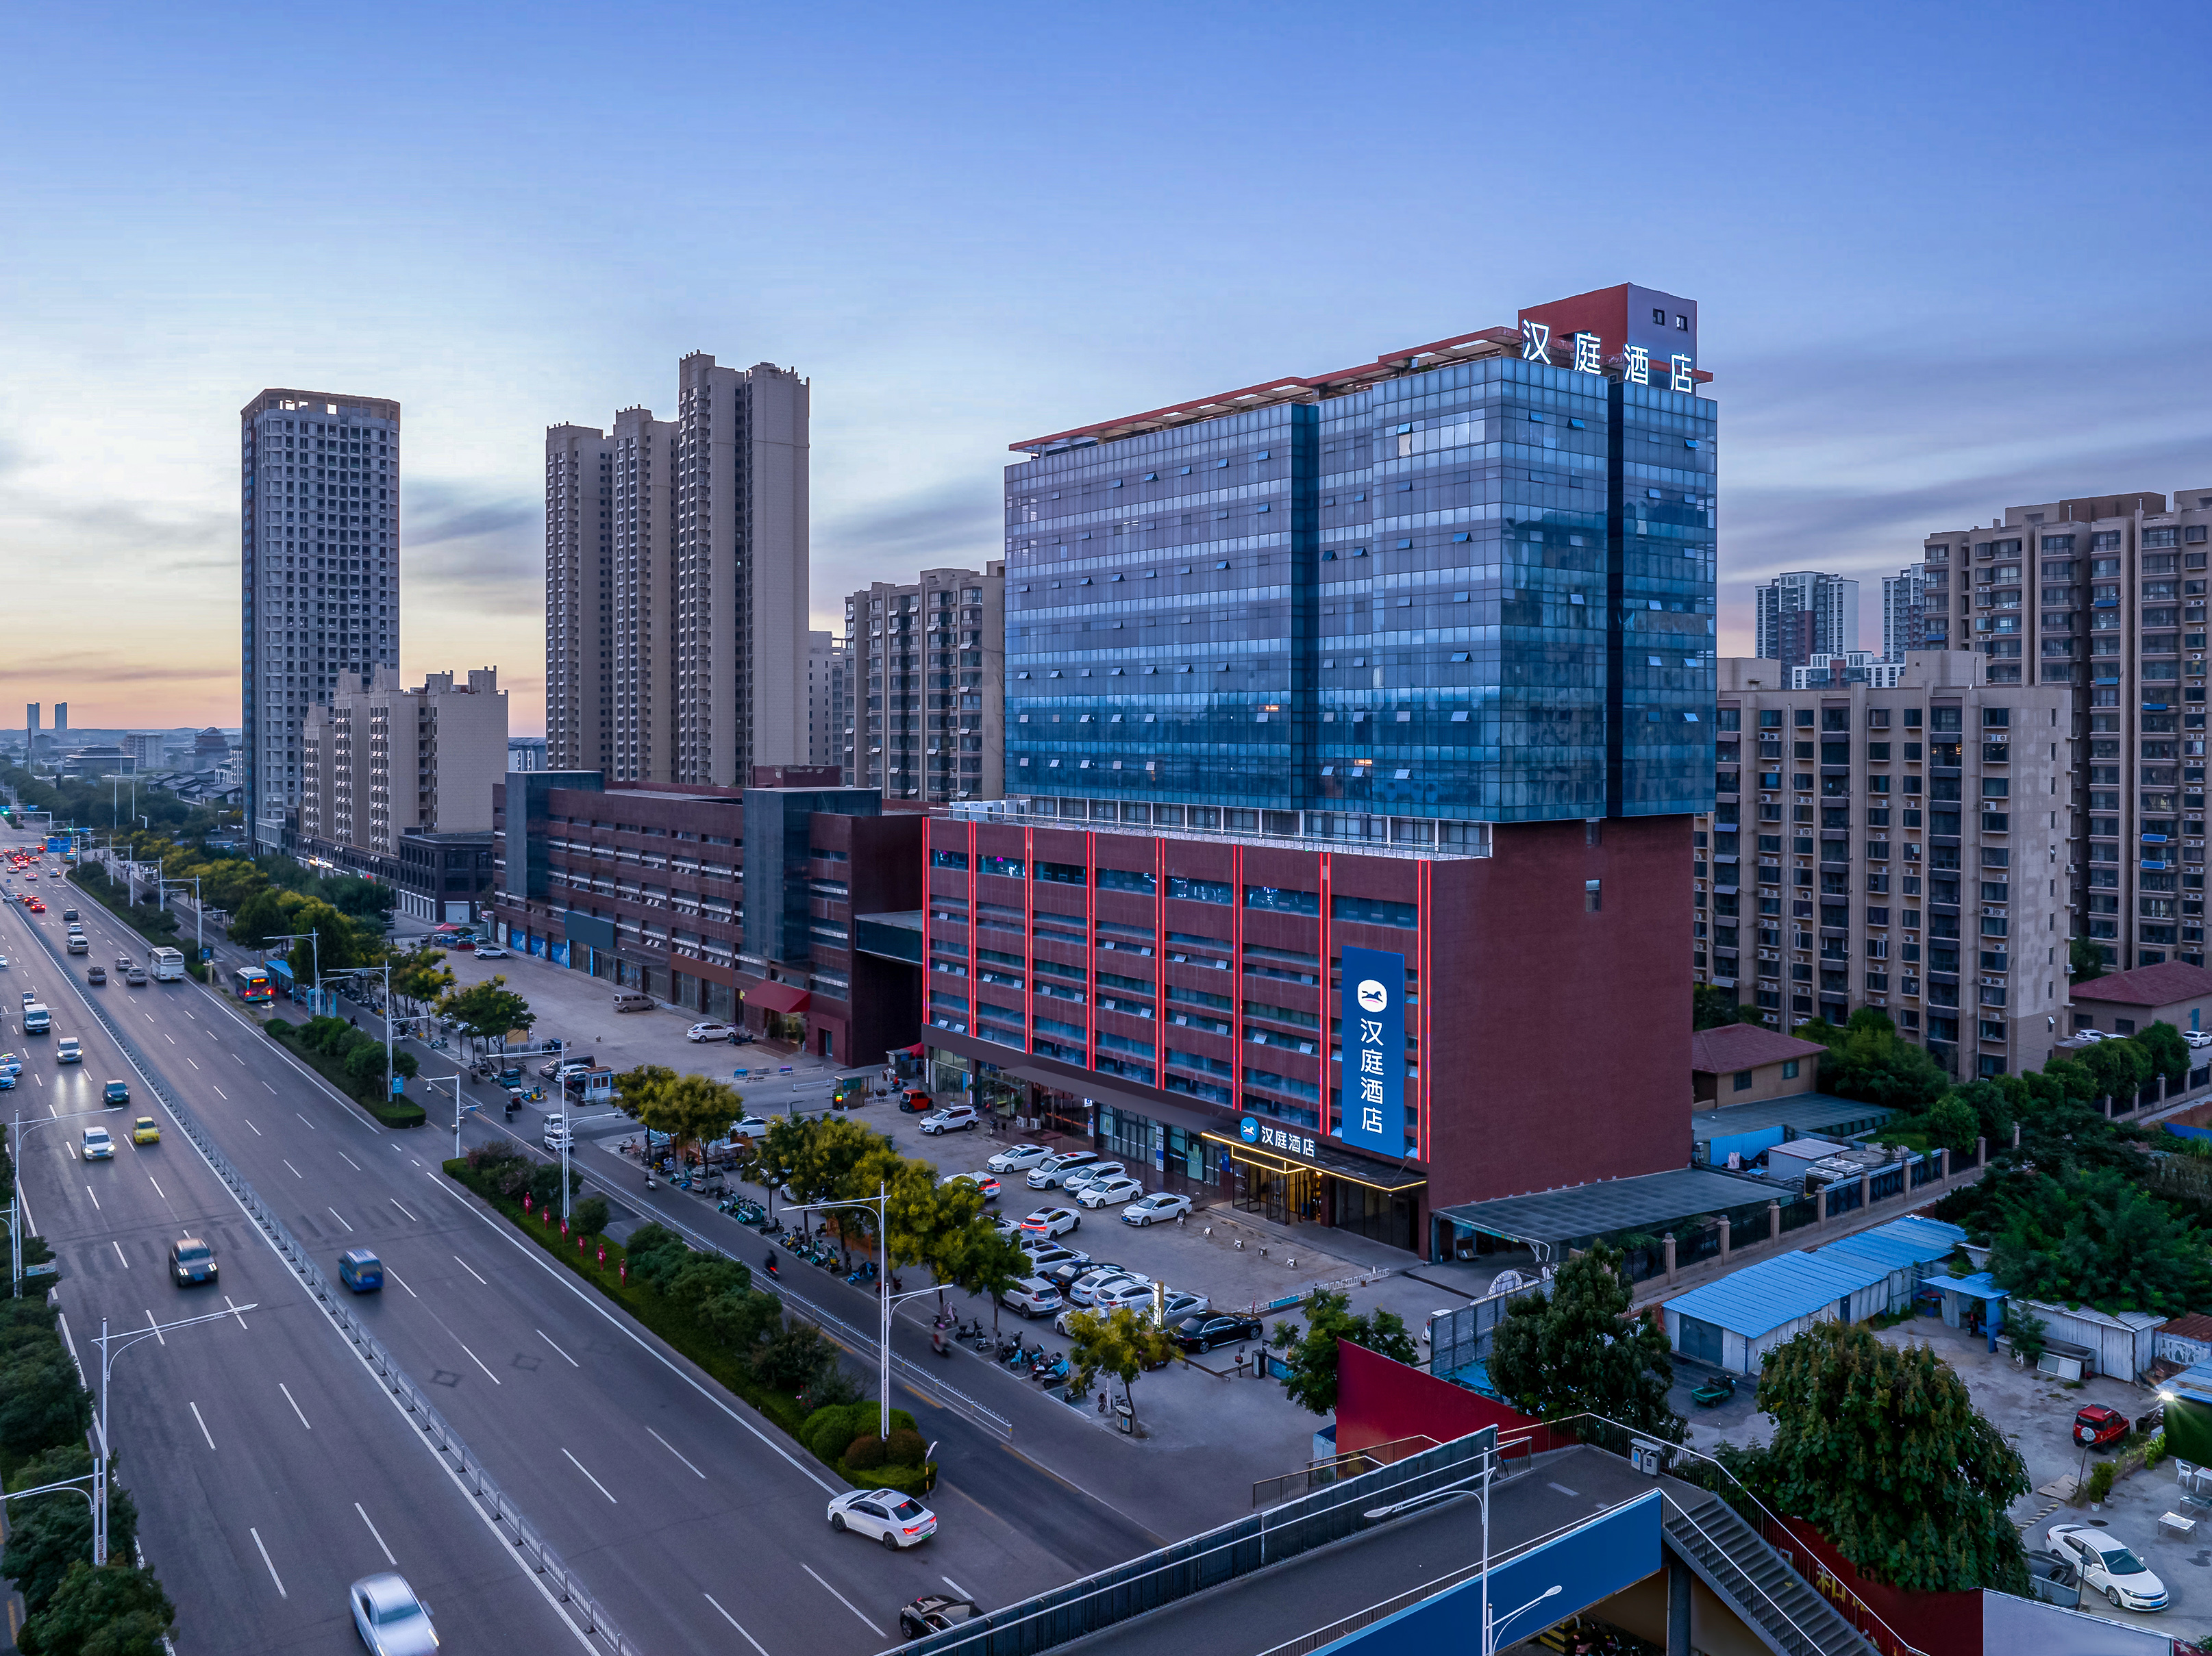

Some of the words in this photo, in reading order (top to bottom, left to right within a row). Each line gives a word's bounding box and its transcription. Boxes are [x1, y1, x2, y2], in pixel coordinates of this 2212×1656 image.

[1522, 319, 1692, 394] 汉庭酒店
[1360, 1018, 1384, 1134] 汉庭酒店
[1261, 1126, 1315, 1157] 汉庭酒店
